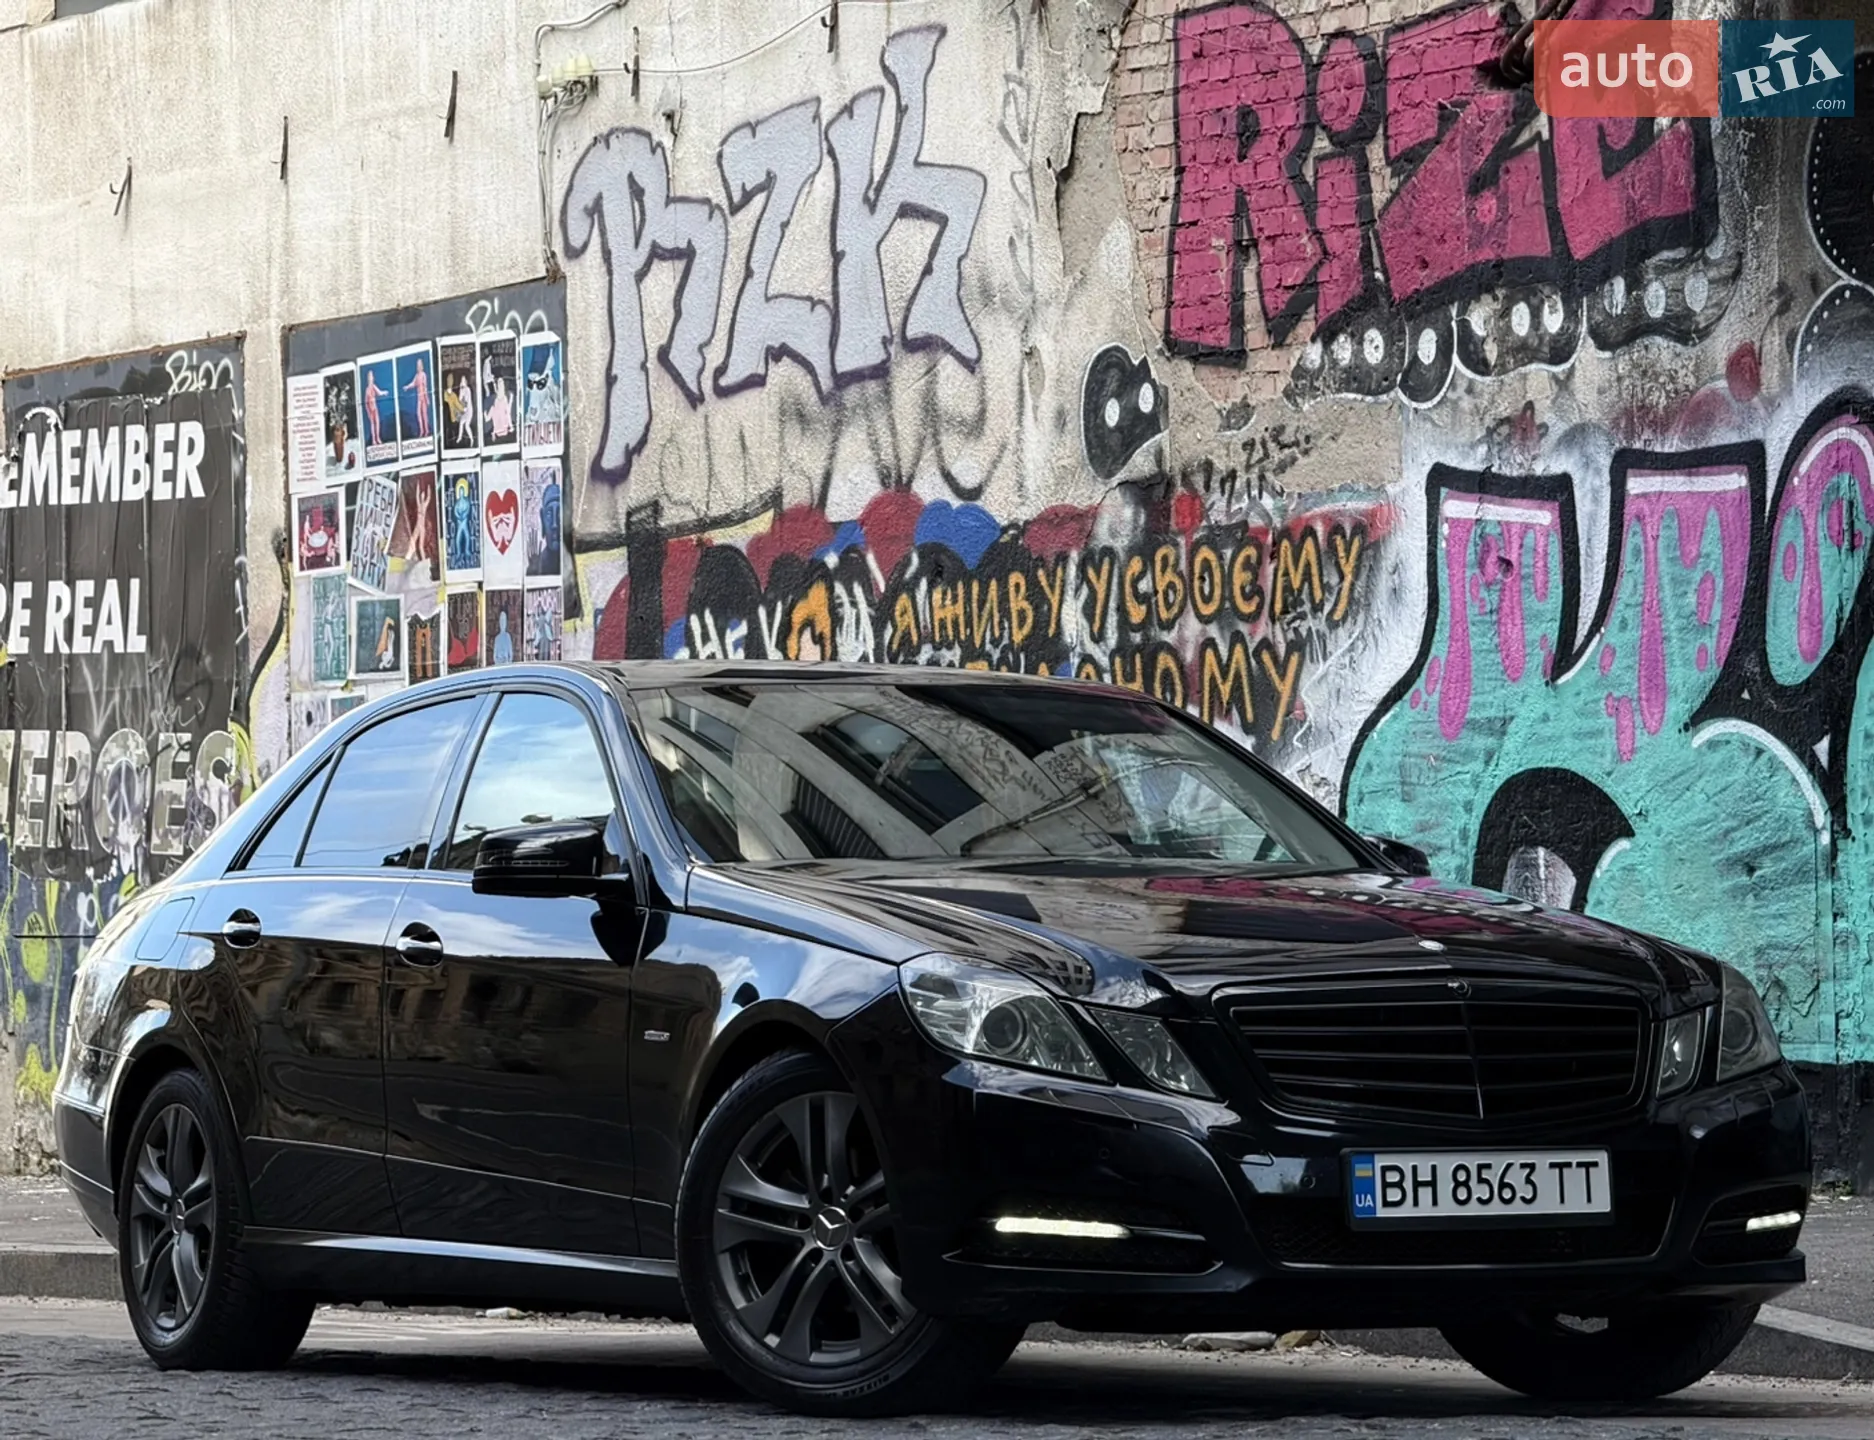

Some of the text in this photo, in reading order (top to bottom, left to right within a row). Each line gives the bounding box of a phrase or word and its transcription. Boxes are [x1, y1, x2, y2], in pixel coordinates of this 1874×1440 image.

[1123, 533, 1361, 625] СВОЄМУ
[44, 578, 147, 654] REAL
[1355, 1193, 1374, 1208] UA
[1379, 1160, 1599, 1208] BH 8563 TT
